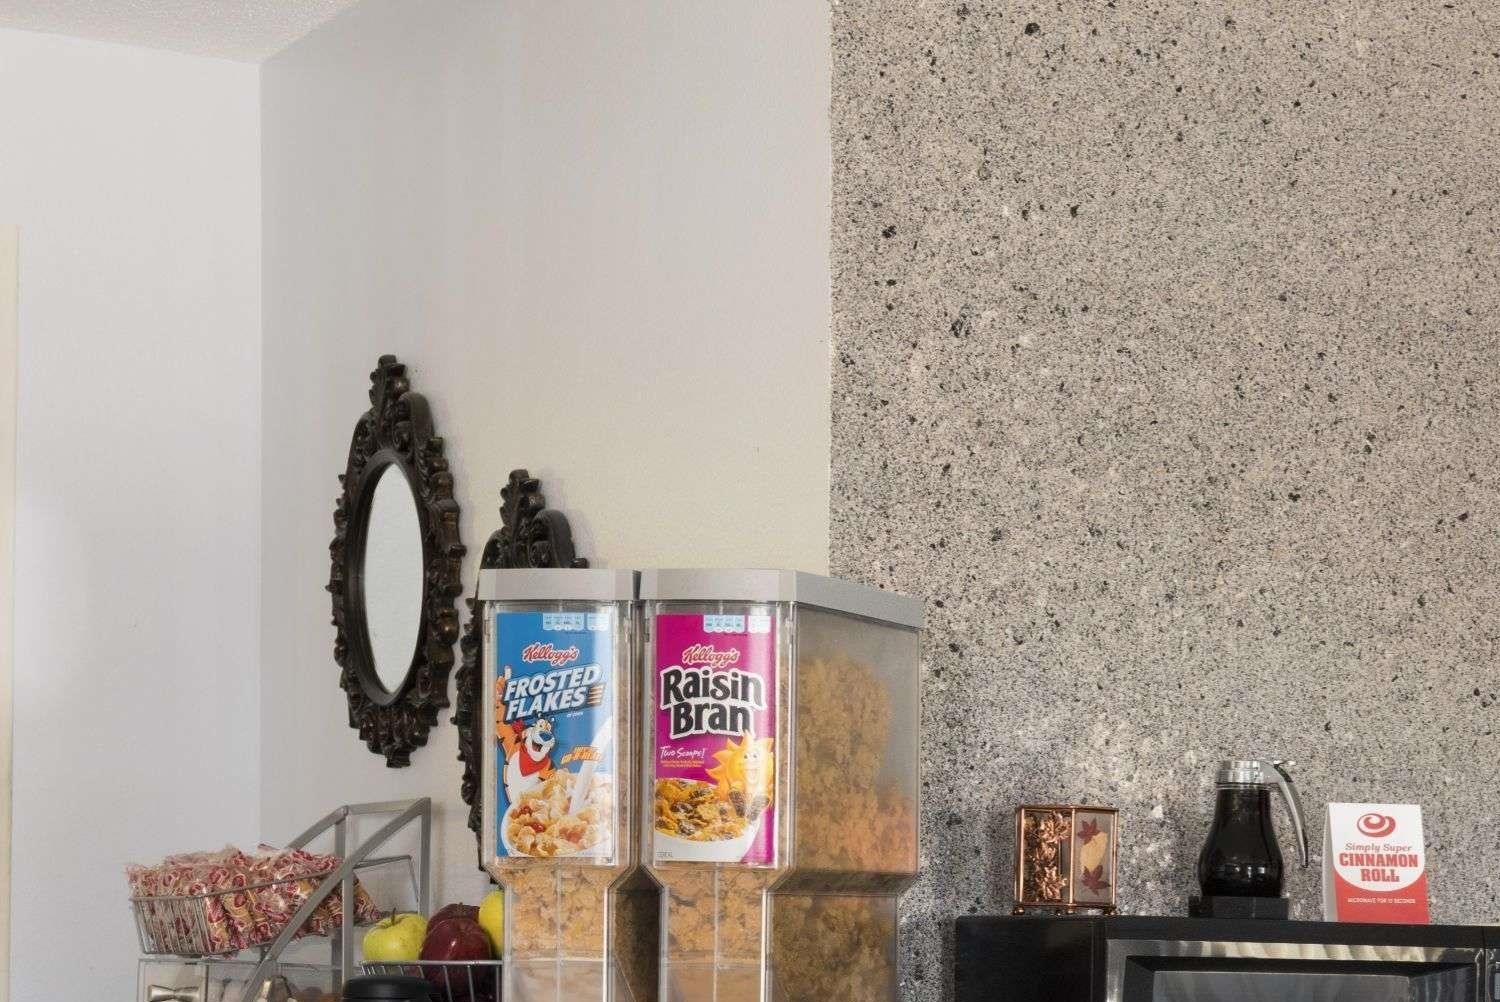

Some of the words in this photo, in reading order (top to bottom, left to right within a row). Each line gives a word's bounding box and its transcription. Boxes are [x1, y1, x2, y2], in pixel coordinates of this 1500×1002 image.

[522, 642, 579, 666] Kellogg's
[682, 644, 740, 667] Kellogg's
[505, 665, 600, 701] FROSTED
[662, 668, 763, 706] Raisin
[506, 686, 587, 720] FLAKES
[673, 702, 751, 735] Bran
[1345, 842, 1380, 854] Simply
[1383, 843, 1412, 854] Super
[1339, 853, 1419, 868] CINNAMON
[1360, 868, 1400, 883] ROLL
